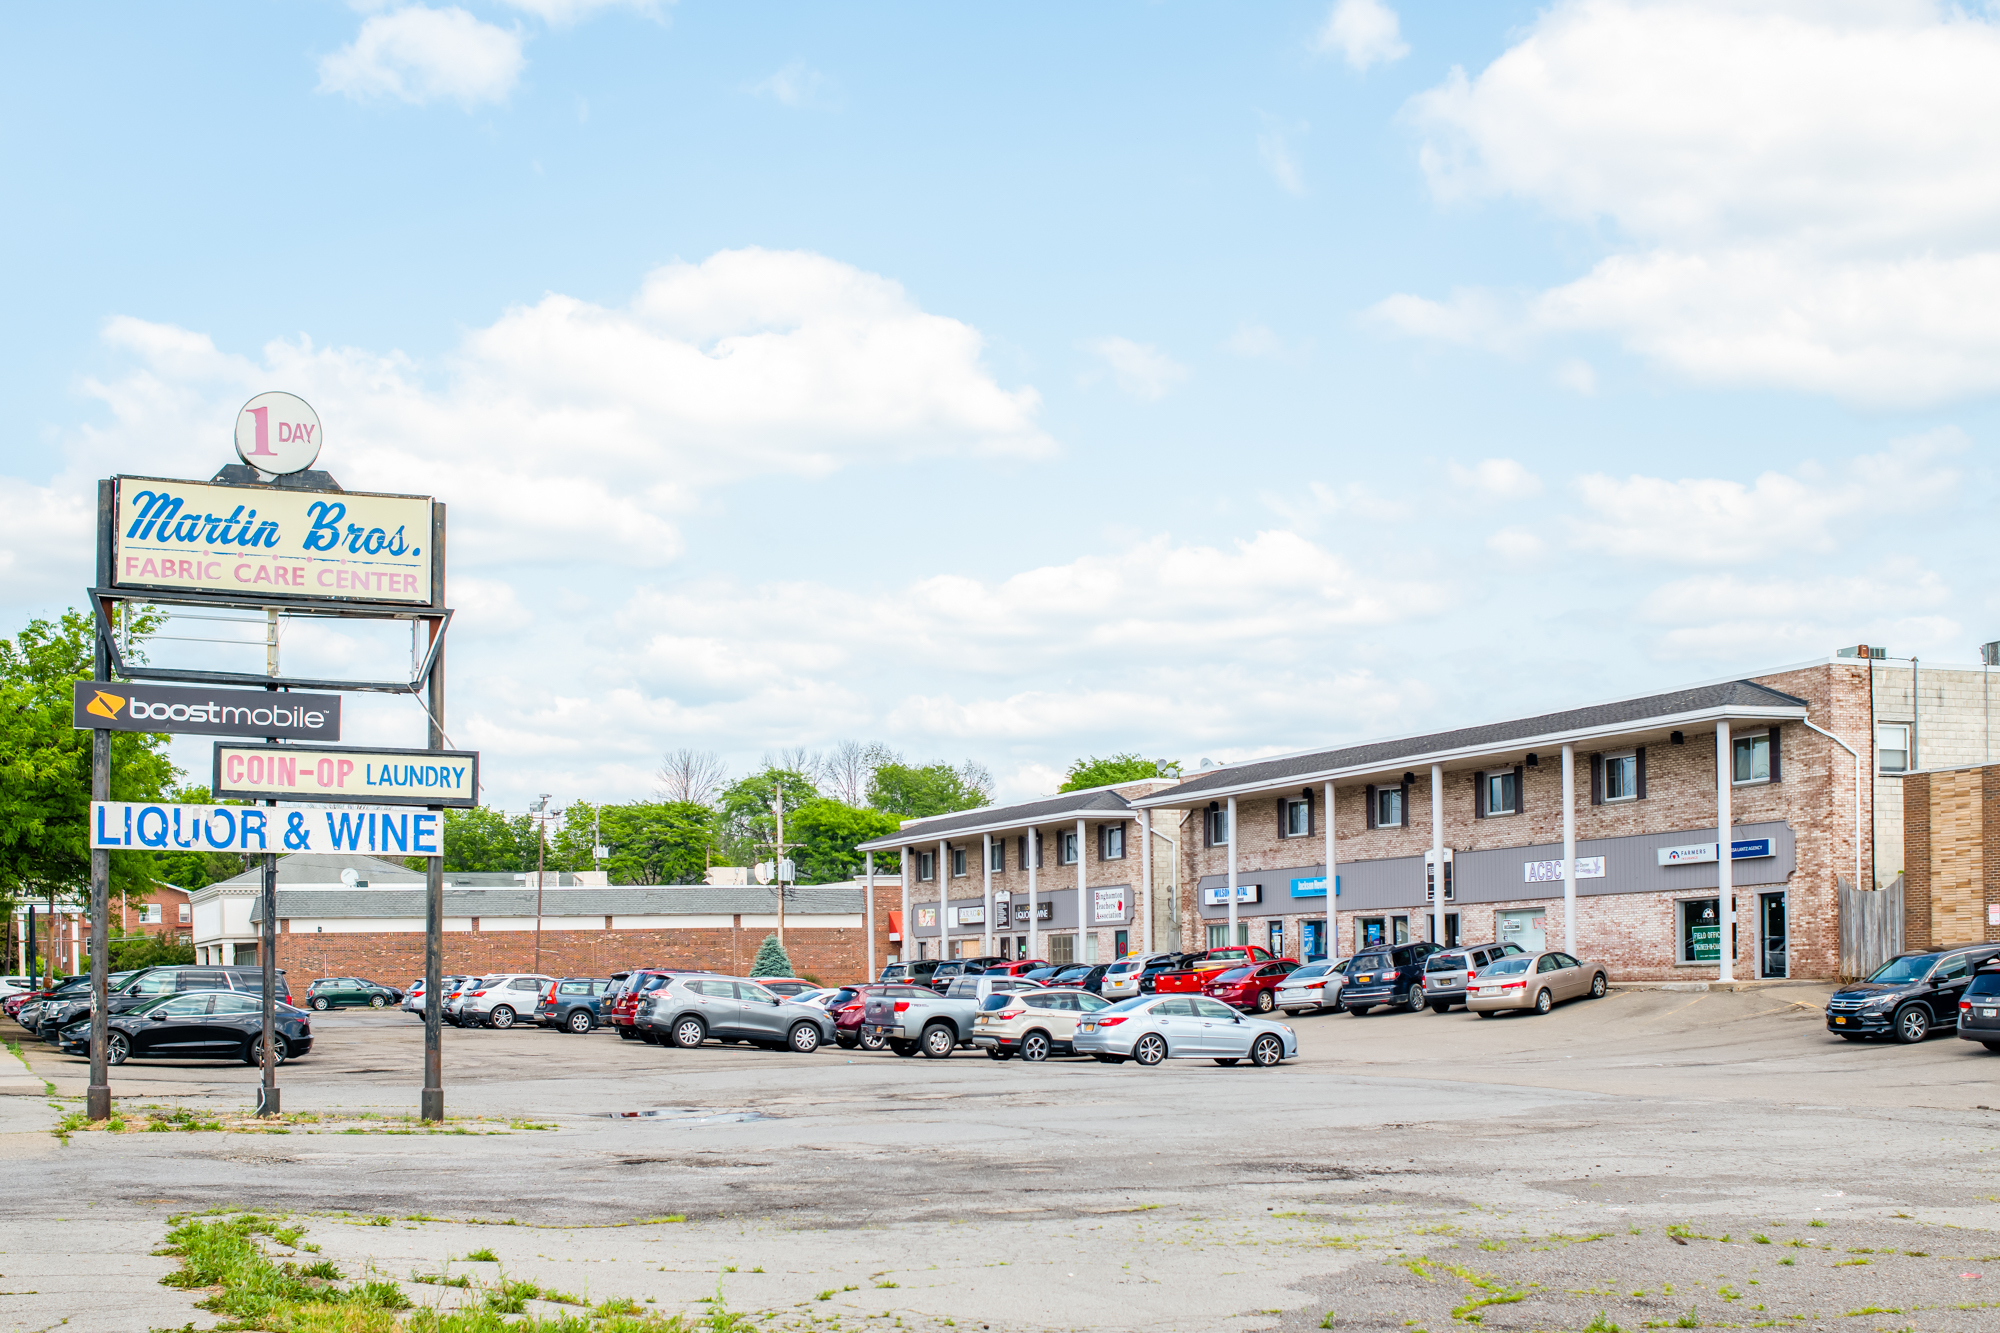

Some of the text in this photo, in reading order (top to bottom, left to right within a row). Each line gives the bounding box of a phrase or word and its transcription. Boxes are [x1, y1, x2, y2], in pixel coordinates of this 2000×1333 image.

[245, 406, 315, 456] 1 DAY
[126, 490, 421, 557] Martin Bros.
[125, 556, 419, 594] FABRIC CARE CENTER
[227, 754, 466, 789] COIN-OP LAUNDRY
[97, 805, 437, 853] LIQUOR & WINE
[1681, 848, 1706, 856] FARMERS
[1529, 861, 1562, 881] ACBC
[1298, 881, 1314, 890] Jackson
[1095, 891, 1123, 901] Binghamton
[1015, 911, 1030, 920] LIQUO
[1095, 911, 1122, 919] Association
[1707, 931, 1720, 939] OFFIC
